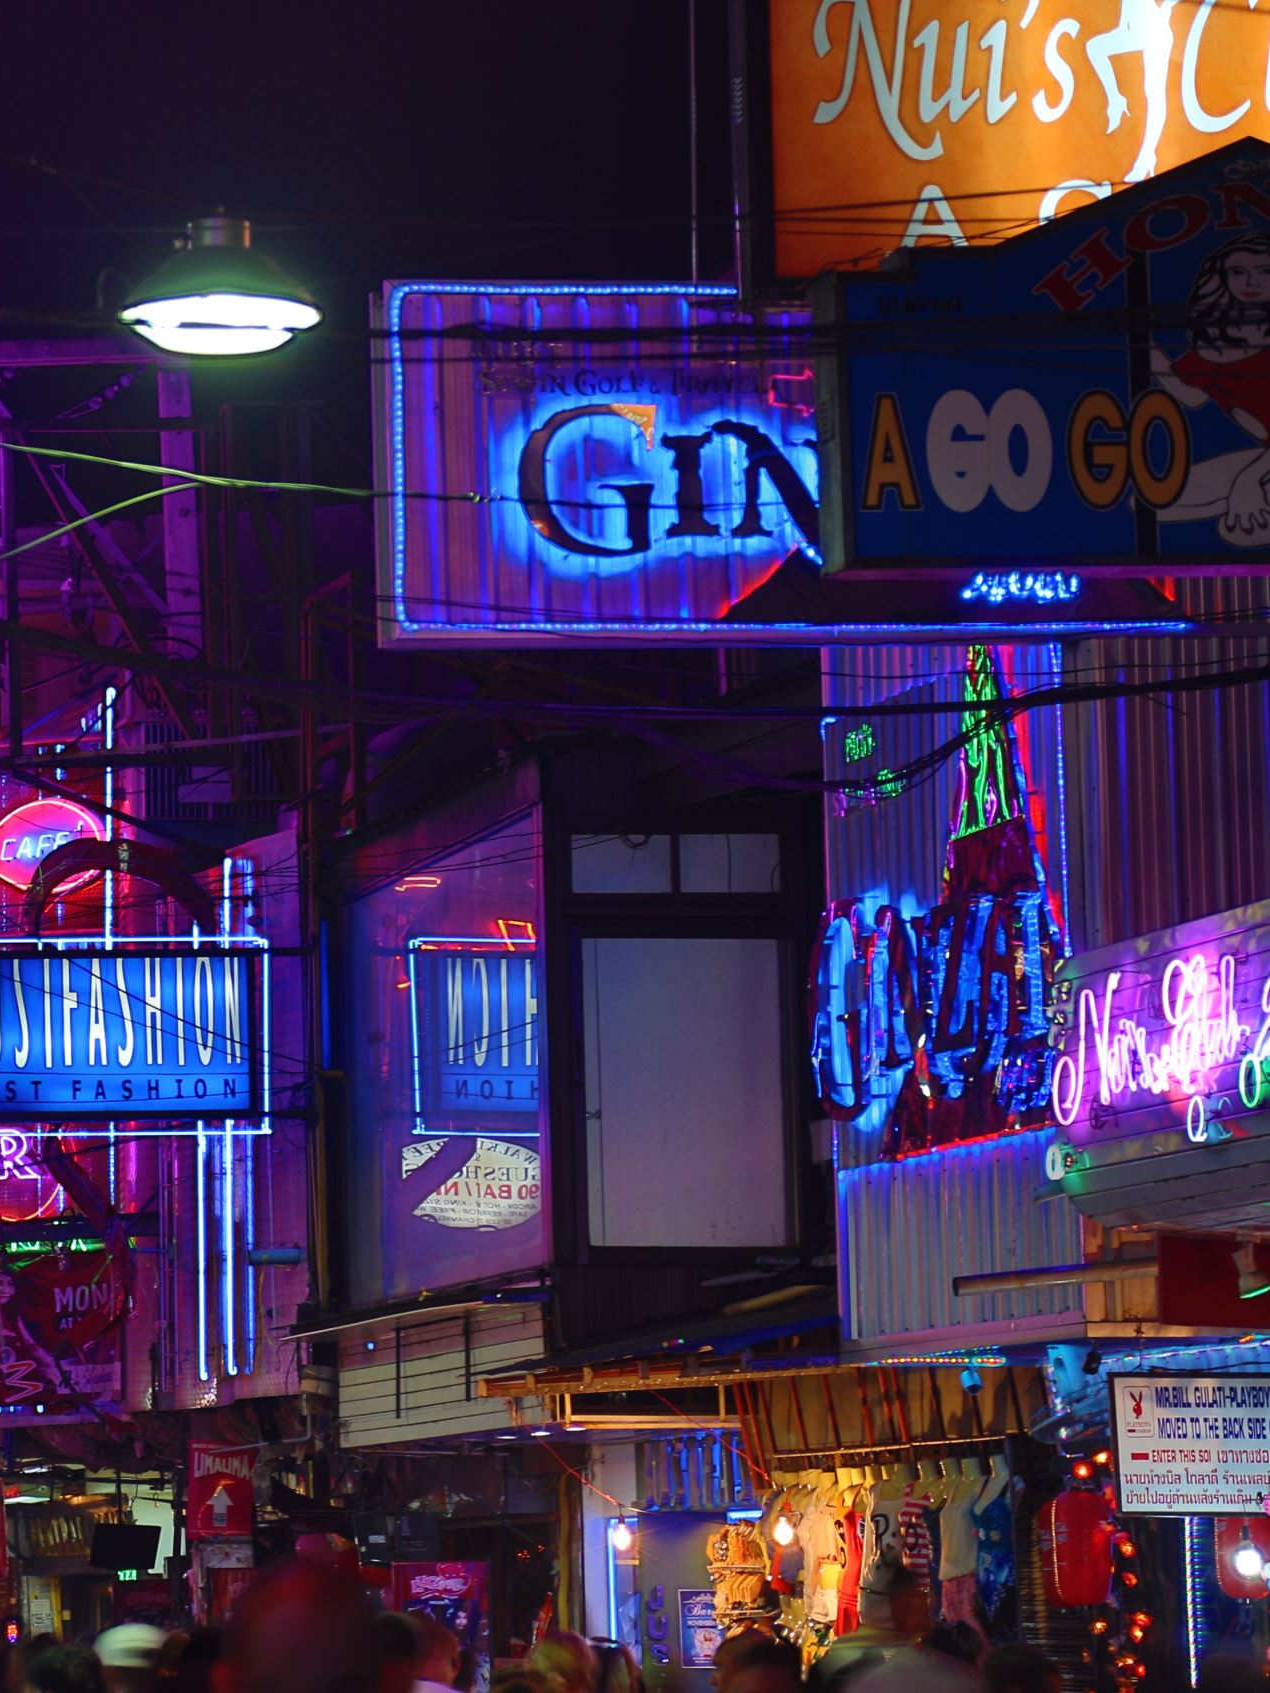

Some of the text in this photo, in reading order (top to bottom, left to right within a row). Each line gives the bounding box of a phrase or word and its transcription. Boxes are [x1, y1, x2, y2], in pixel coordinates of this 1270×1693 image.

[1067, 387, 1191, 511] GO
[71, 1077, 237, 1101] FASHION
[1157, 1416, 1267, 1440] MOVED TO THE BACK SIDE
[1151, 1449, 1177, 1463] ENTER
[1179, 1449, 1197, 1463] THIS
